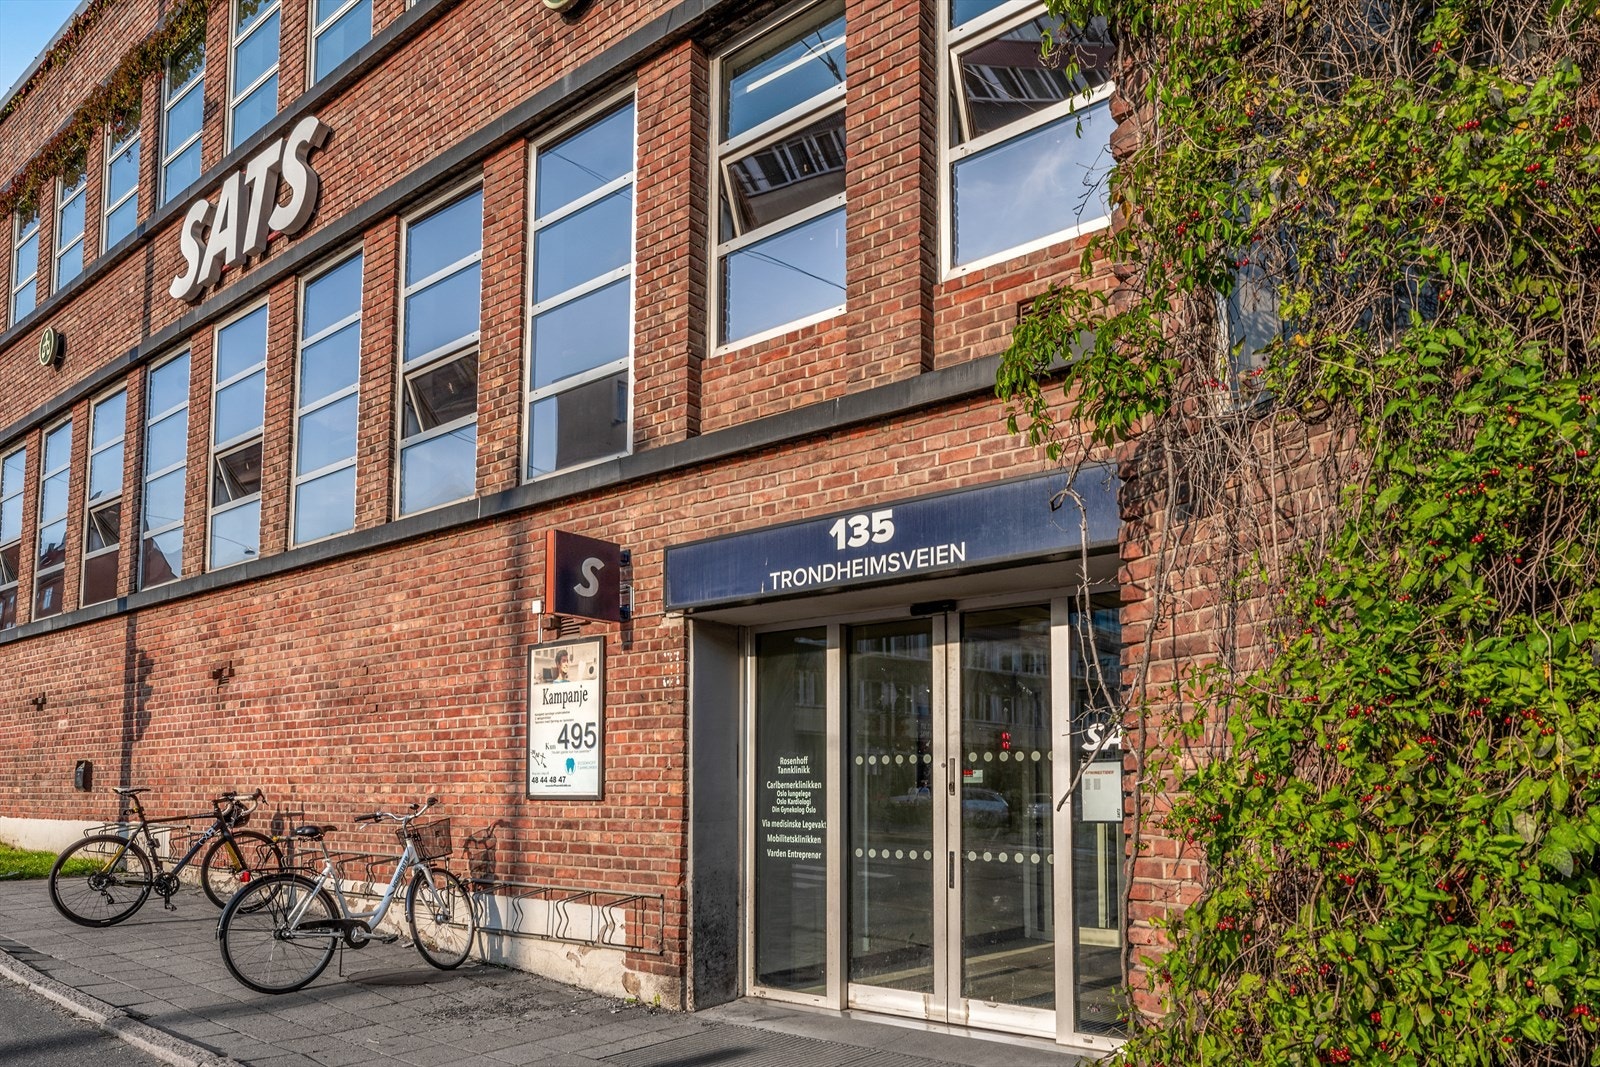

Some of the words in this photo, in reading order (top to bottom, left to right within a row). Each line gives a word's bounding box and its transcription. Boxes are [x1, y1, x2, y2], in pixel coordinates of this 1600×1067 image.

[169, 115, 332, 302] SATS
[828, 508, 895, 551] 135
[769, 541, 966, 591] TRONDHEIMSVEIEN
[574, 557, 604, 597] S
[542, 685, 588, 709] Kampanje
[557, 722, 597, 750] 495
[780, 756, 808, 765] Rosenhoff
[778, 766, 810, 774] Tannklinikk
[767, 781, 821, 789] Carlbernerklinikken
[788, 798, 811, 806] Kardiologi
[781, 806, 805, 814] Gynekolog
[762, 819, 771, 828] Via
[772, 820, 801, 828] medisinske
[767, 834, 821, 843] Mobilitetsklinikken
[767, 849, 786, 858] Varden
